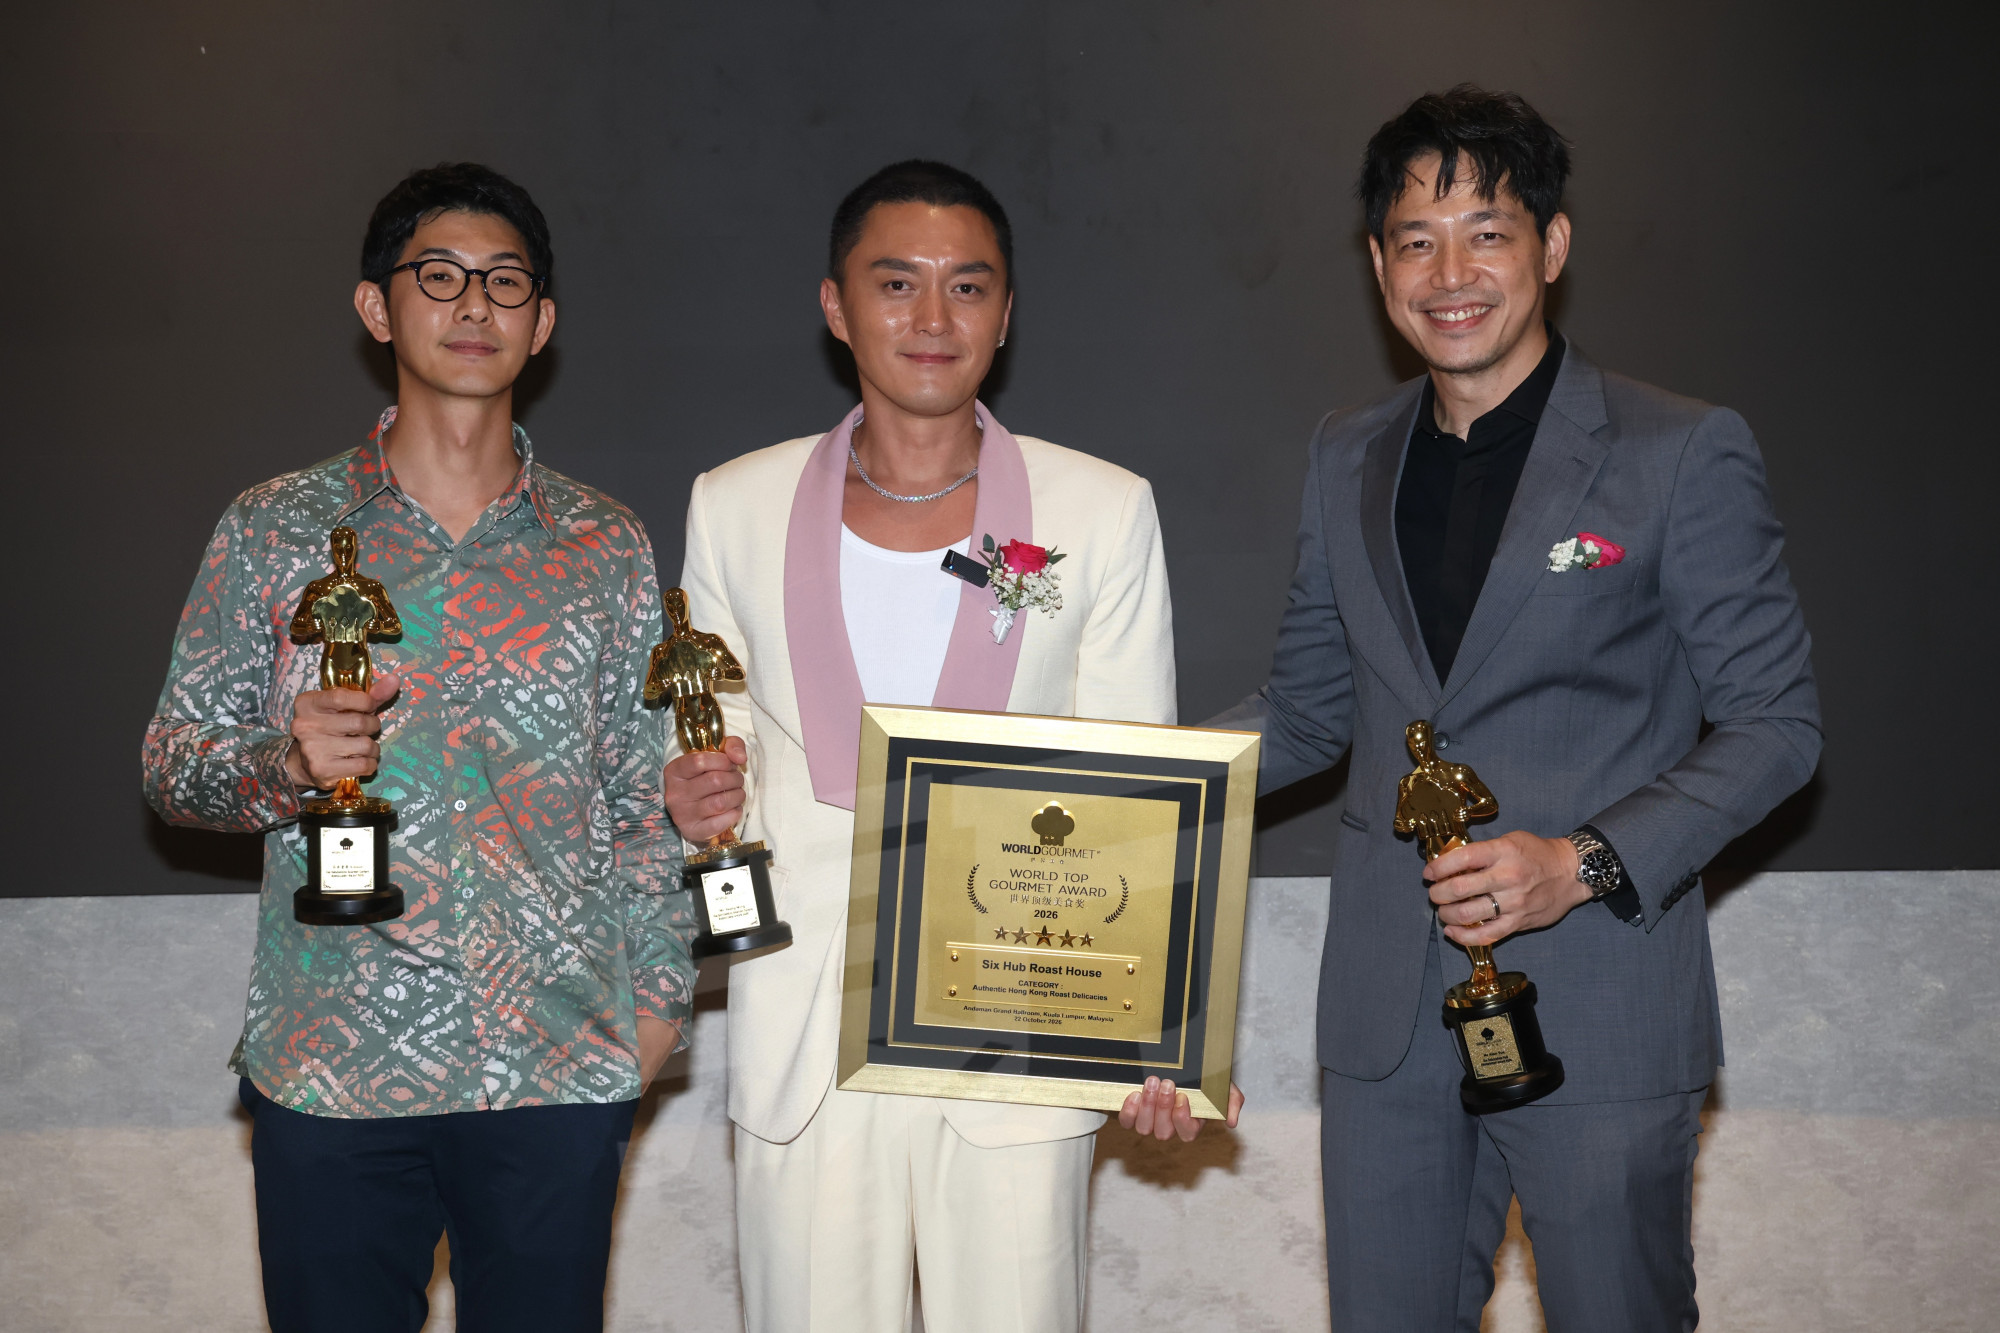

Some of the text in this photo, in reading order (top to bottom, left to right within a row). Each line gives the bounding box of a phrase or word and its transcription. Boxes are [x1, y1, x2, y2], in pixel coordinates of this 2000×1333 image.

[1009, 868, 1089, 883] WORLD TOP
[989, 879, 1107, 898] GOURMET AWARD
[1009, 893, 1085, 909] 世界顶级美食奖
[1033, 909, 1059, 919] 2026
[982, 959, 1102, 978] Six Hub Roast House
[1018, 980, 1059, 989] CATEGORY
[972, 984, 1108, 1001] Authentic Hong Kong Roast Delicacies
[1022, 1016, 1047, 1024] October
